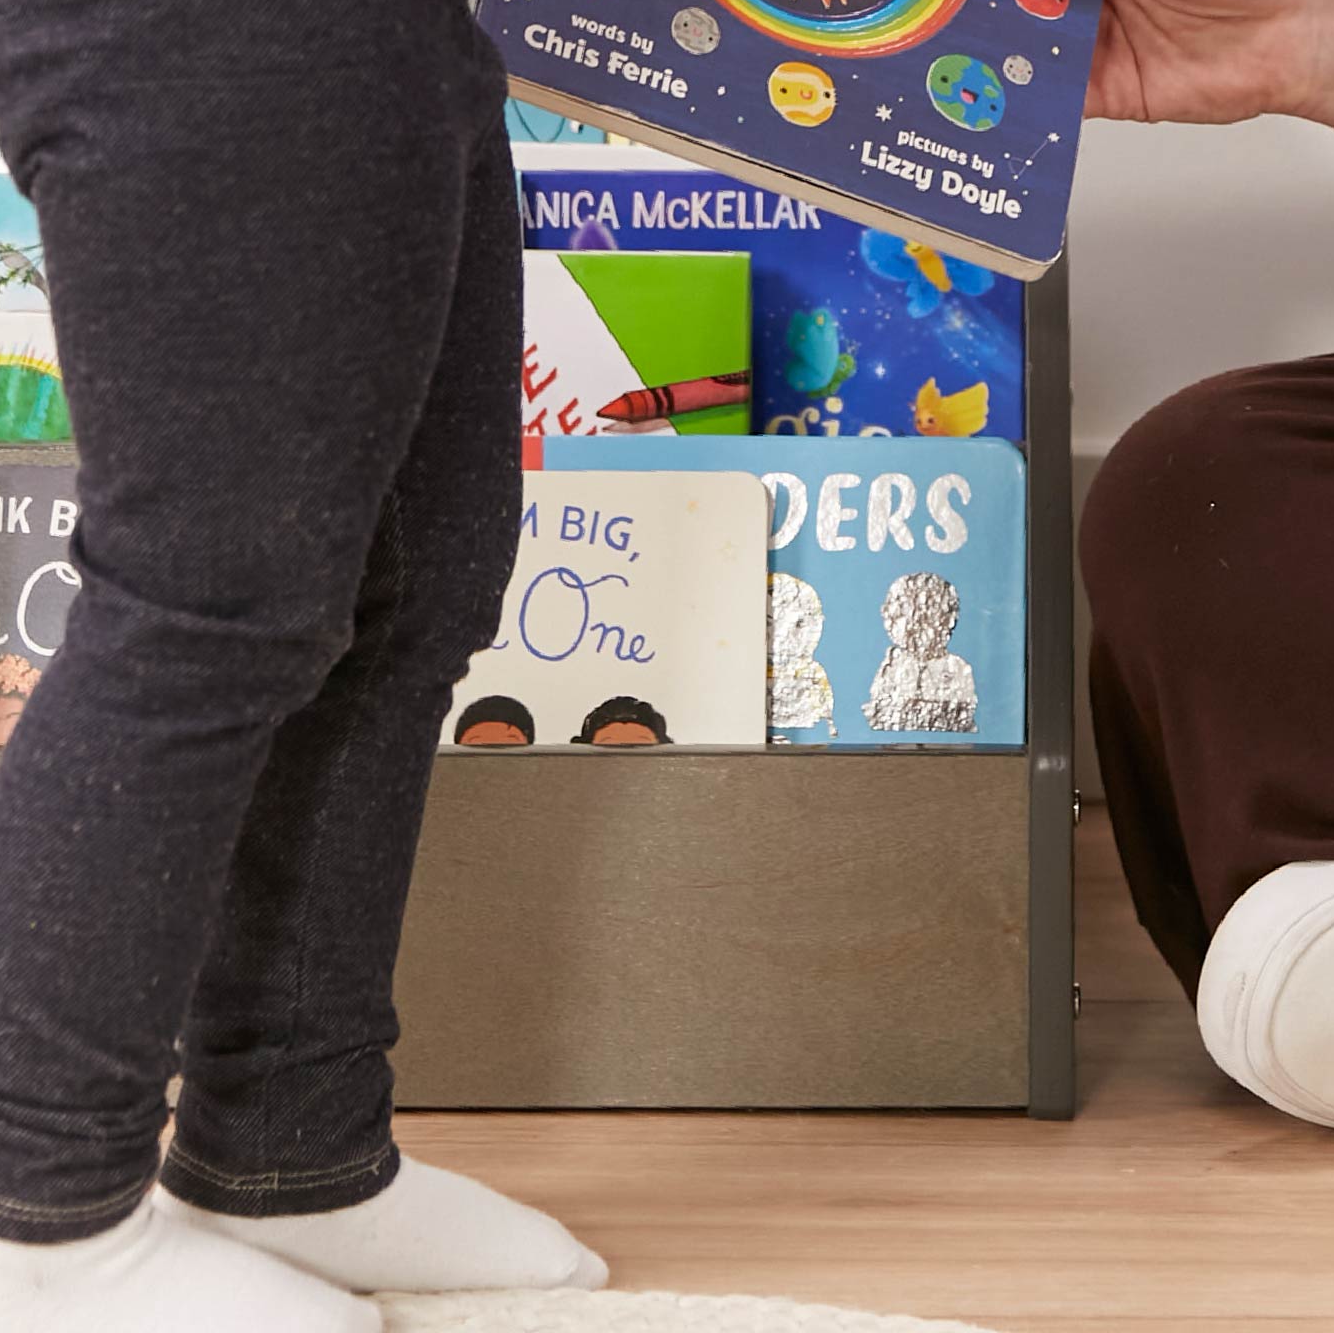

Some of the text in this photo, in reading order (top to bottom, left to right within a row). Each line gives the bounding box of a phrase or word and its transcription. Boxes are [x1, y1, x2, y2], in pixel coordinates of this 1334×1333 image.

[524, 24, 688, 98] Chris Ferrie
[571, 14, 654, 55] words by
[860, 141, 1022, 218] Lizzy Doyle
[897, 130, 995, 178] pictures by
[560, 505, 640, 563] BIG,
[519, 567, 656, 663] One
